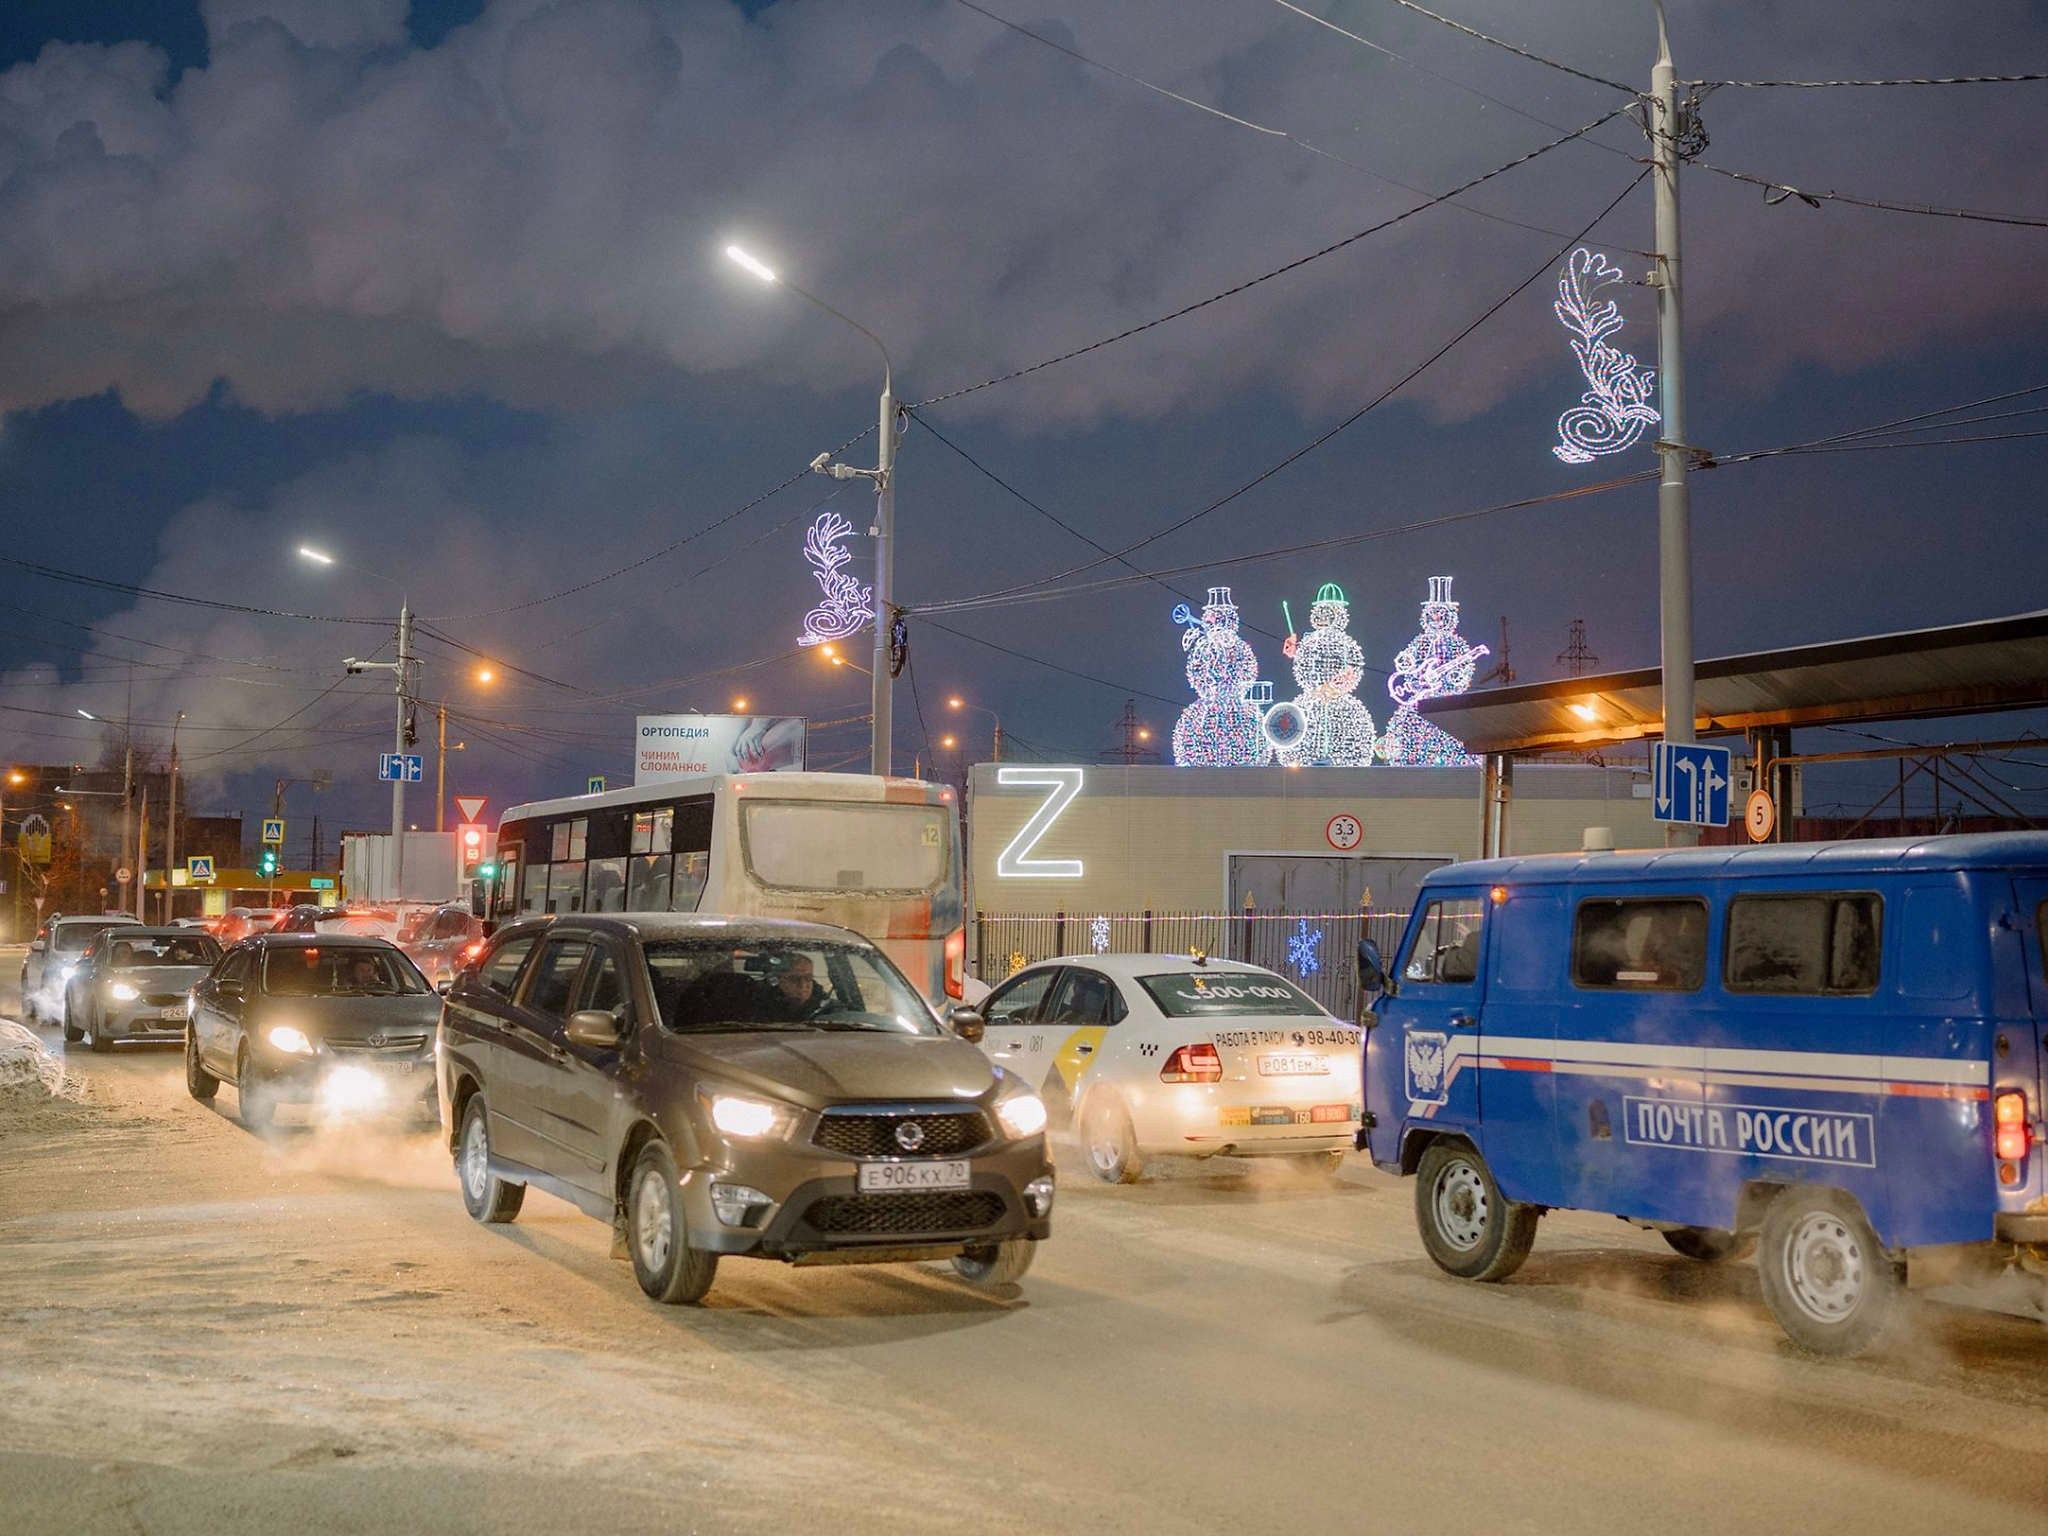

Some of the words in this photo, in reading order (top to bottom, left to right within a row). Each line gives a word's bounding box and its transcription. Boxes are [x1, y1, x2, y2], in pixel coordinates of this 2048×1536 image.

[641, 727, 709, 738] ОРТОПЕДИЯ
[641, 750, 680, 761] ЧИНИМ
[640, 761, 709, 773] СЛОМАННОЕ
[998, 767, 1083, 877] Z
[1756, 806, 1764, 825] 5
[925, 827, 939, 842] 12
[1215, 1032, 1250, 1048] РАБОТА
[1251, 1031, 1257, 1046] В
[1258, 1031, 1285, 1046] ТАКСИ
[1637, 1102, 1727, 1147] ПОЧТА
[1736, 1111, 1857, 1160] РОССИИ
[947, 1163, 965, 1178] 70
